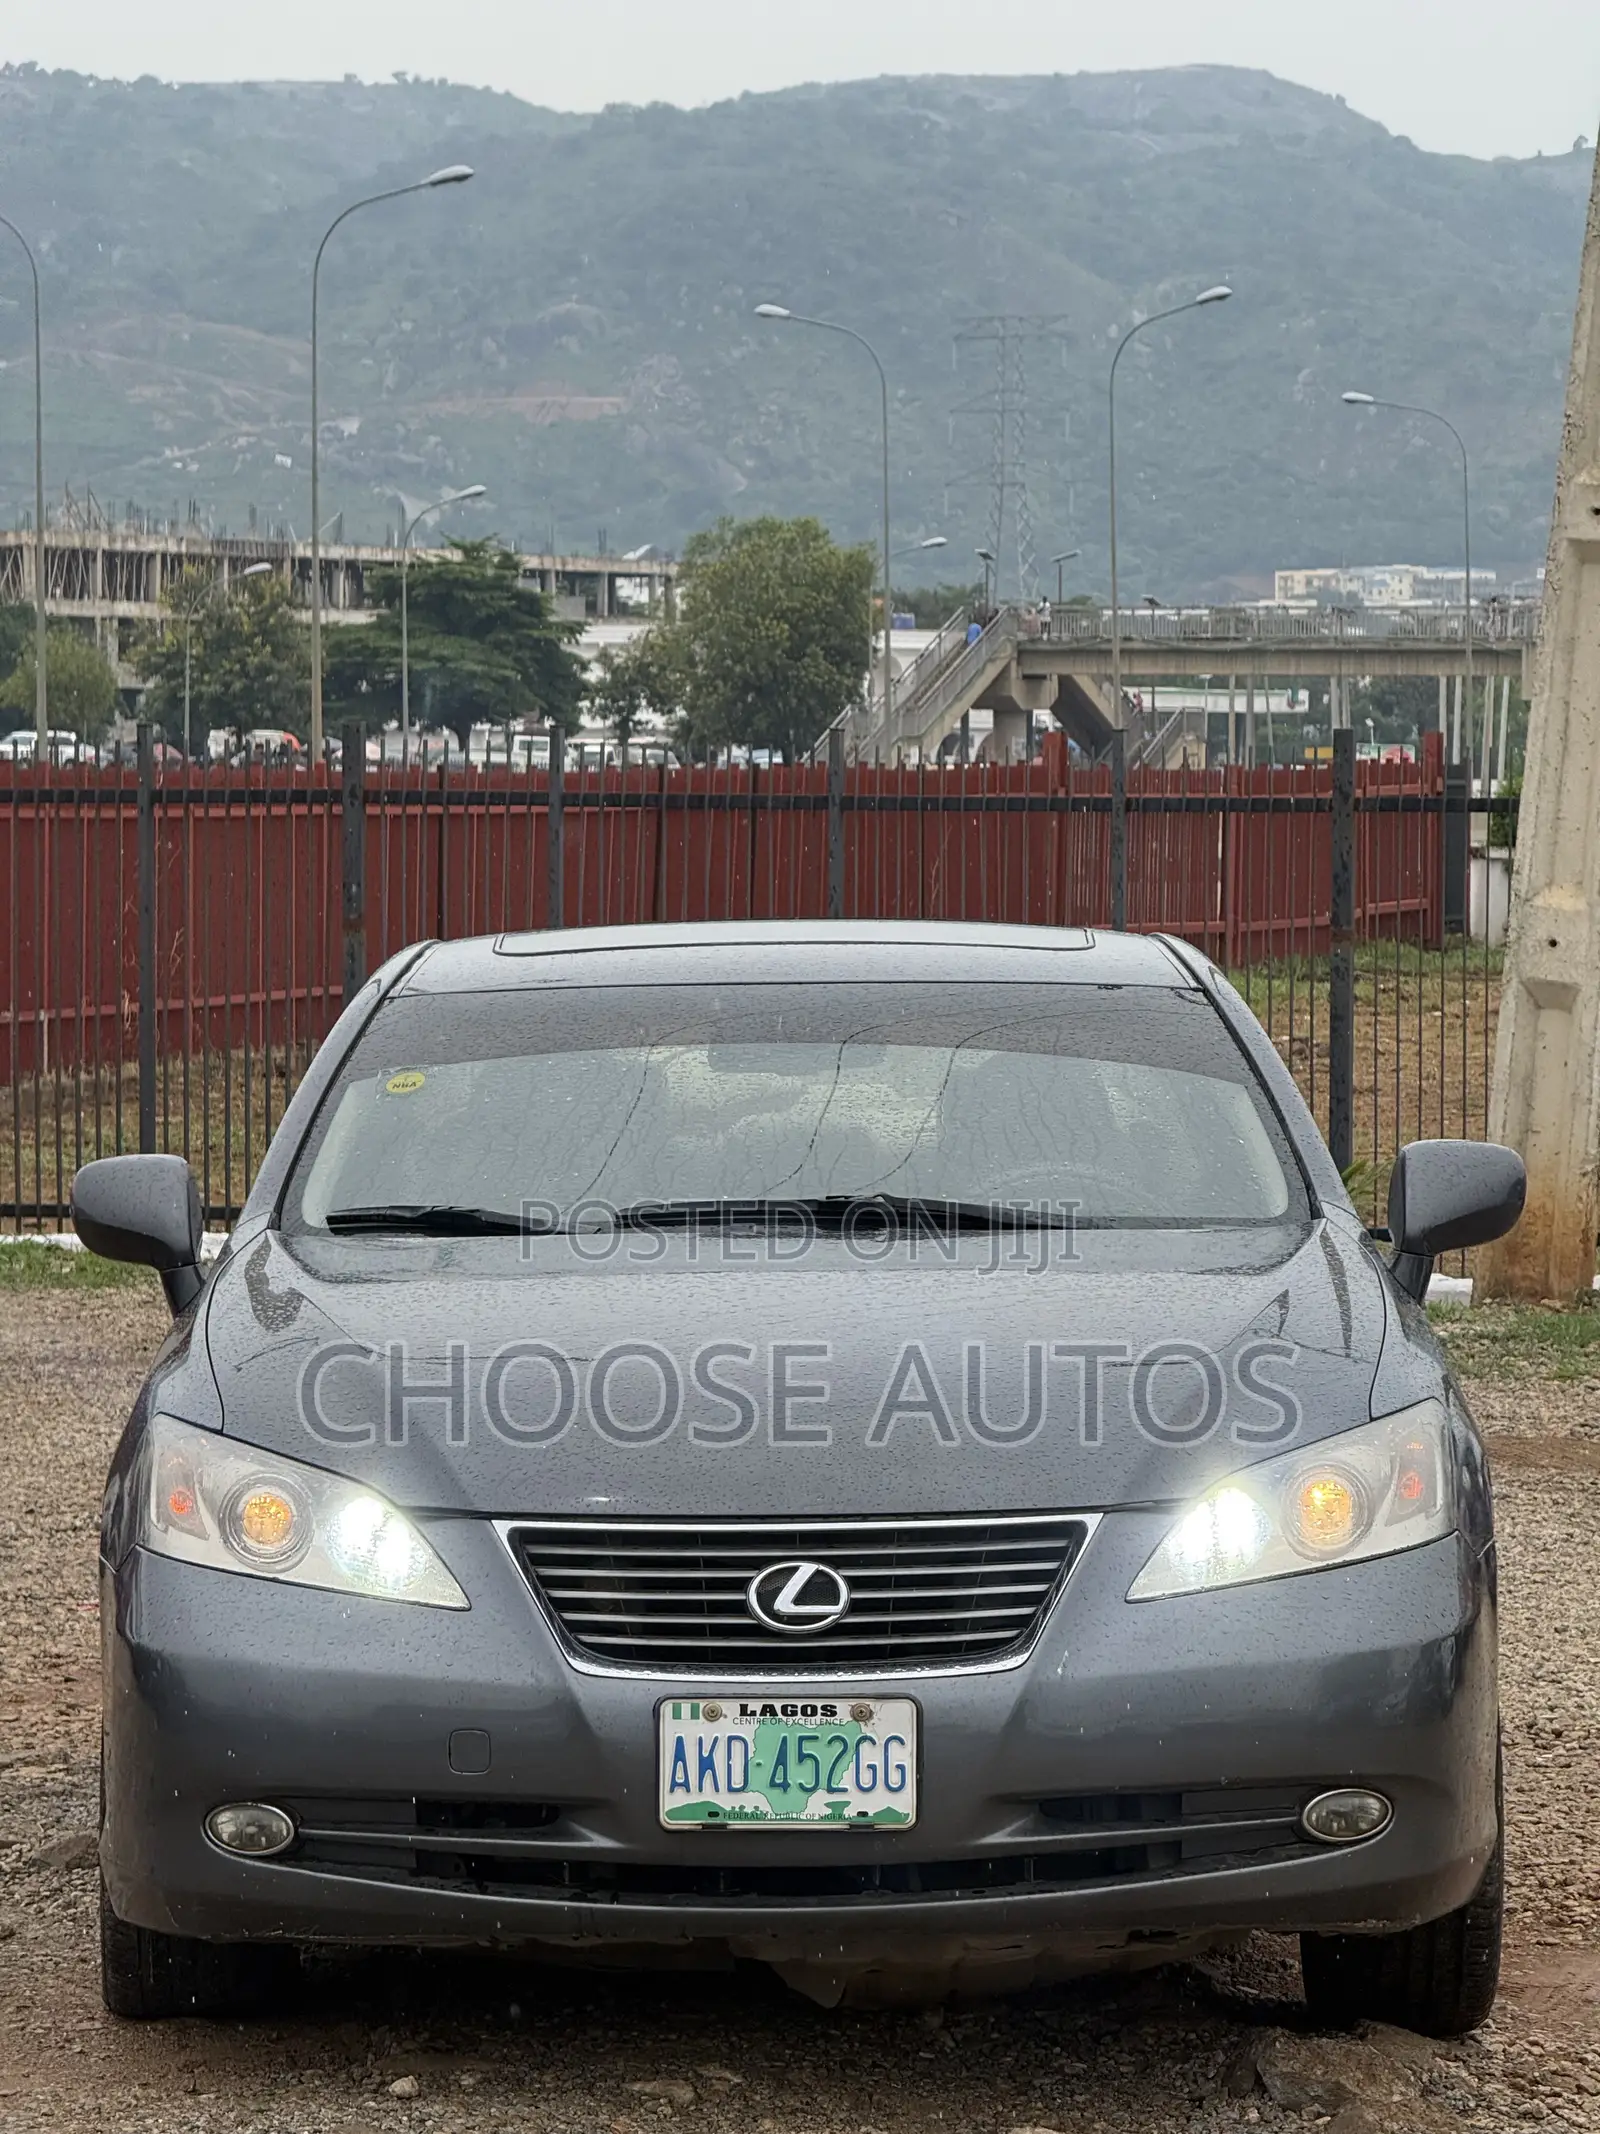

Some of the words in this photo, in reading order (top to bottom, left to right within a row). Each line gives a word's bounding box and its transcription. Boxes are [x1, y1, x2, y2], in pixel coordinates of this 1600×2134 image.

[739, 1703, 838, 1717] LAGOS
[732, 1717, 768, 1726] CENTRE
[769, 1717, 783, 1726] OF
[785, 1717, 845, 1726] EXCELLENCE
[723, 1812, 760, 1820] FEDERAL
[804, 1812, 817, 1820] OF
[818, 1812, 853, 1820] NIGERIA
